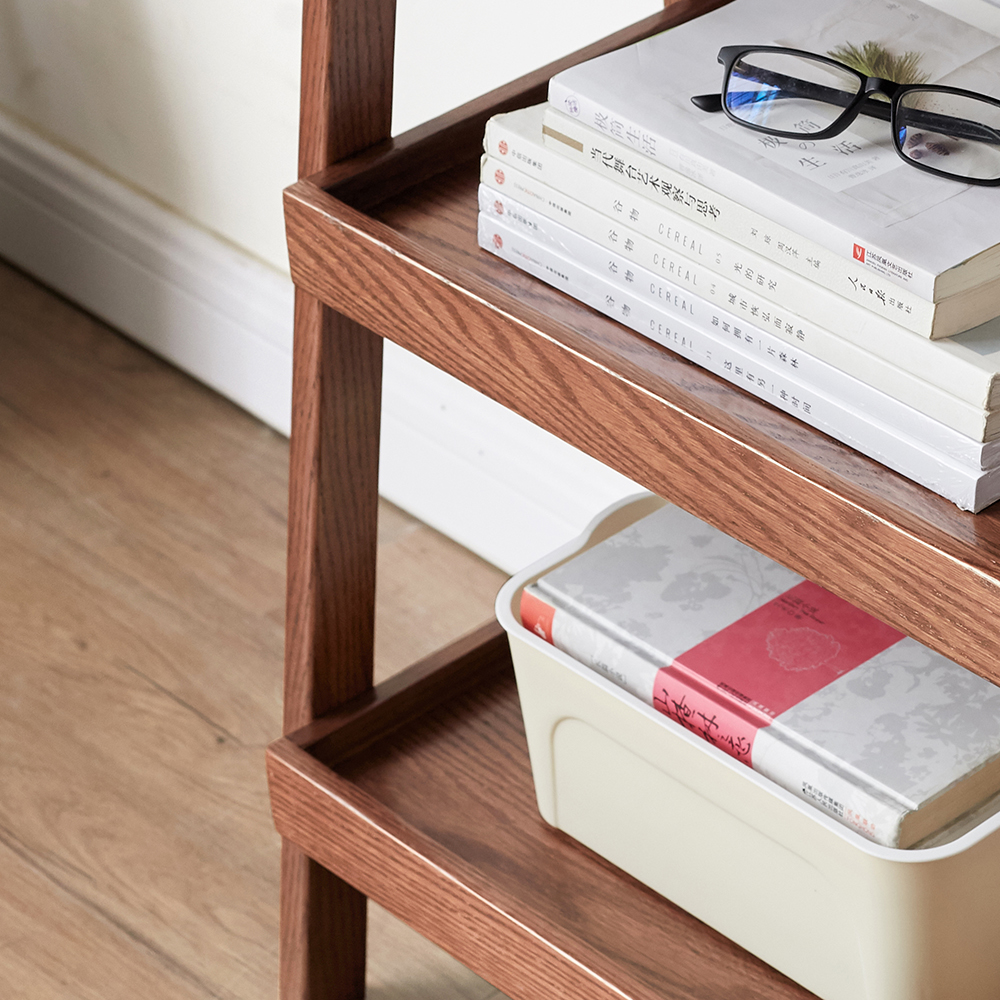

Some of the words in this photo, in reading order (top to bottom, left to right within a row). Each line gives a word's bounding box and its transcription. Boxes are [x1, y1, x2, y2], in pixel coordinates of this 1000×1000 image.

[593, 112, 657, 157] 极简生活
[589, 146, 721, 222] 当代舞台艺术观察与思考
[607, 229, 635, 252] 谷物
[652, 252, 698, 286] CEREAL
[612, 199, 640, 222] 谷物
[658, 222, 704, 256] CEREAL
[714, 251, 723, 265] 05
[733, 262, 778, 292] 光的研究
[607, 260, 635, 283] 谷物
[649, 282, 695, 316] CEREAL
[711, 315, 800, 369] 如何拥有一片森林
[649, 319, 694, 352] CEREAL
[723, 360, 812, 415] 这里有另一种时间
